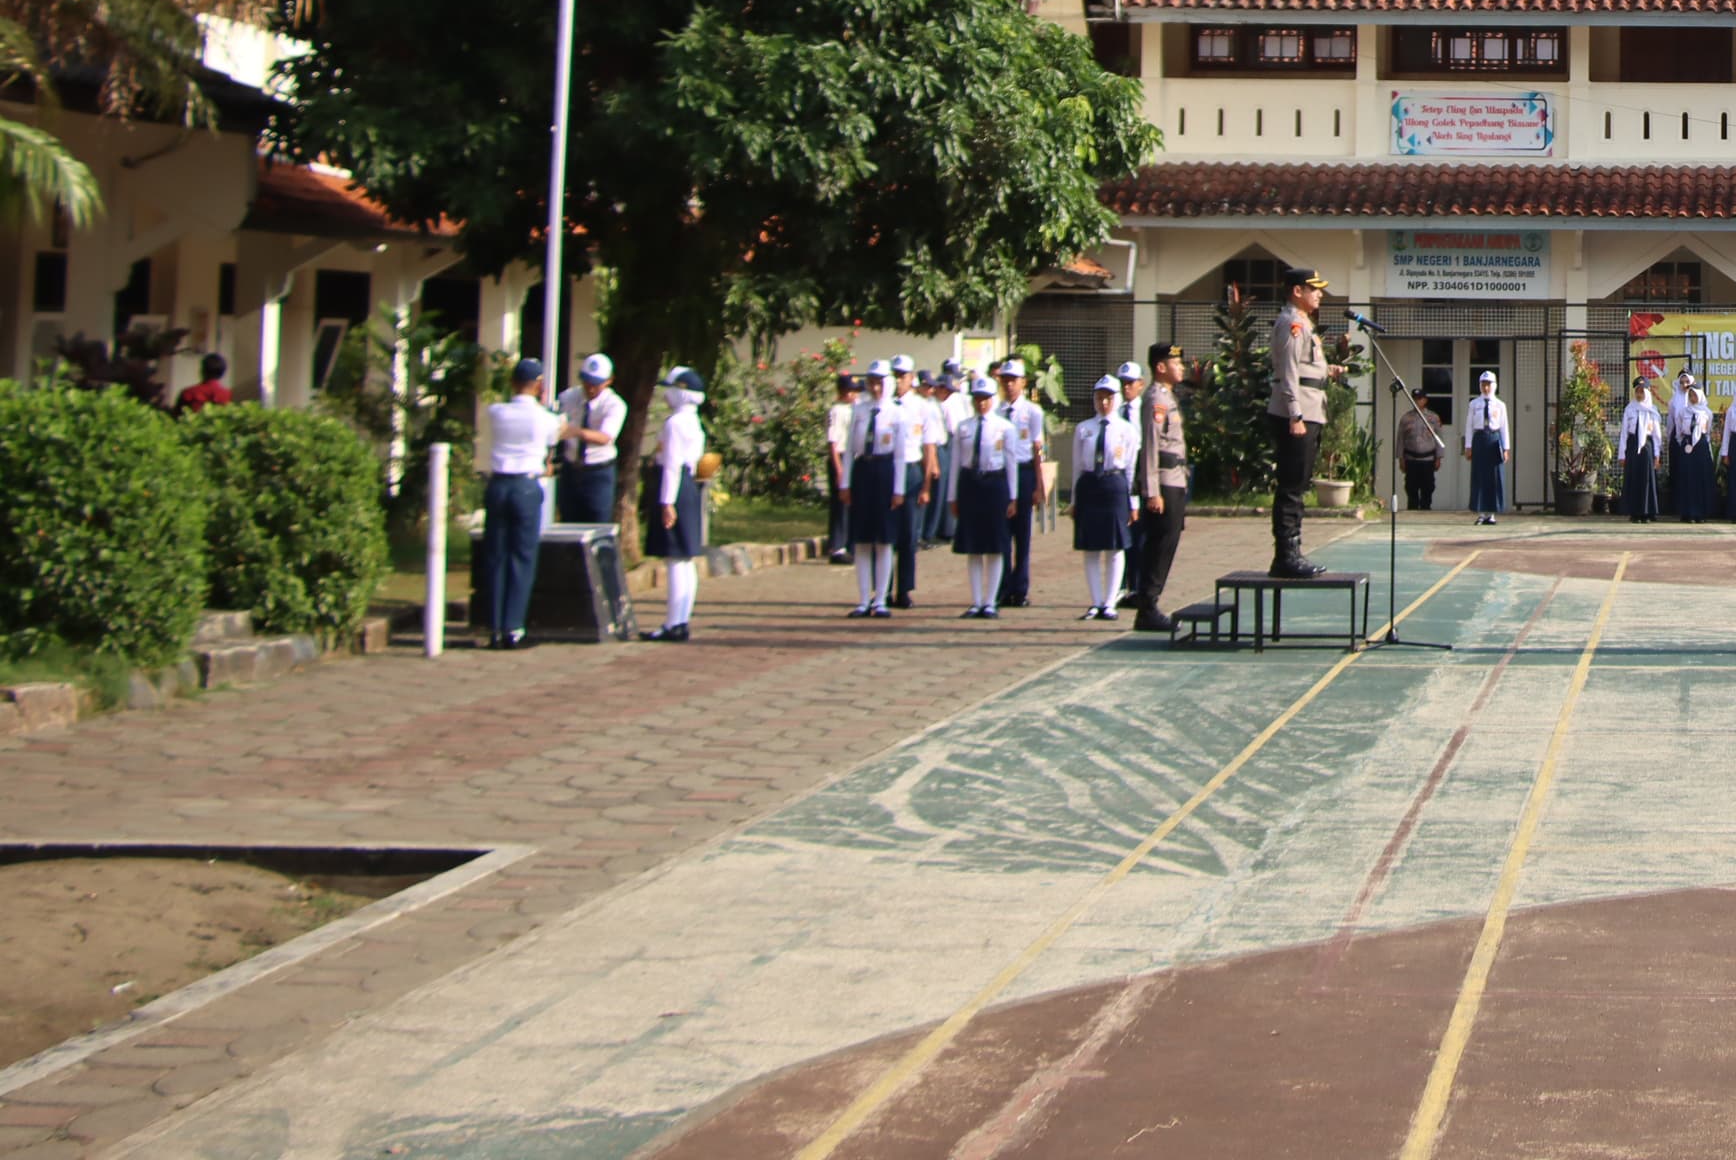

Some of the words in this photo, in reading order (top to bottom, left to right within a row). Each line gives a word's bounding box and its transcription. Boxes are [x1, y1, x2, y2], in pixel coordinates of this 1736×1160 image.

[1394, 255, 1414, 265] SMP
[1417, 256, 1452, 266] NEGERI
[1455, 256, 1460, 266] 1
[1463, 256, 1541, 267] BANJARNEGARA
[1408, 282, 1430, 290] NPP.
